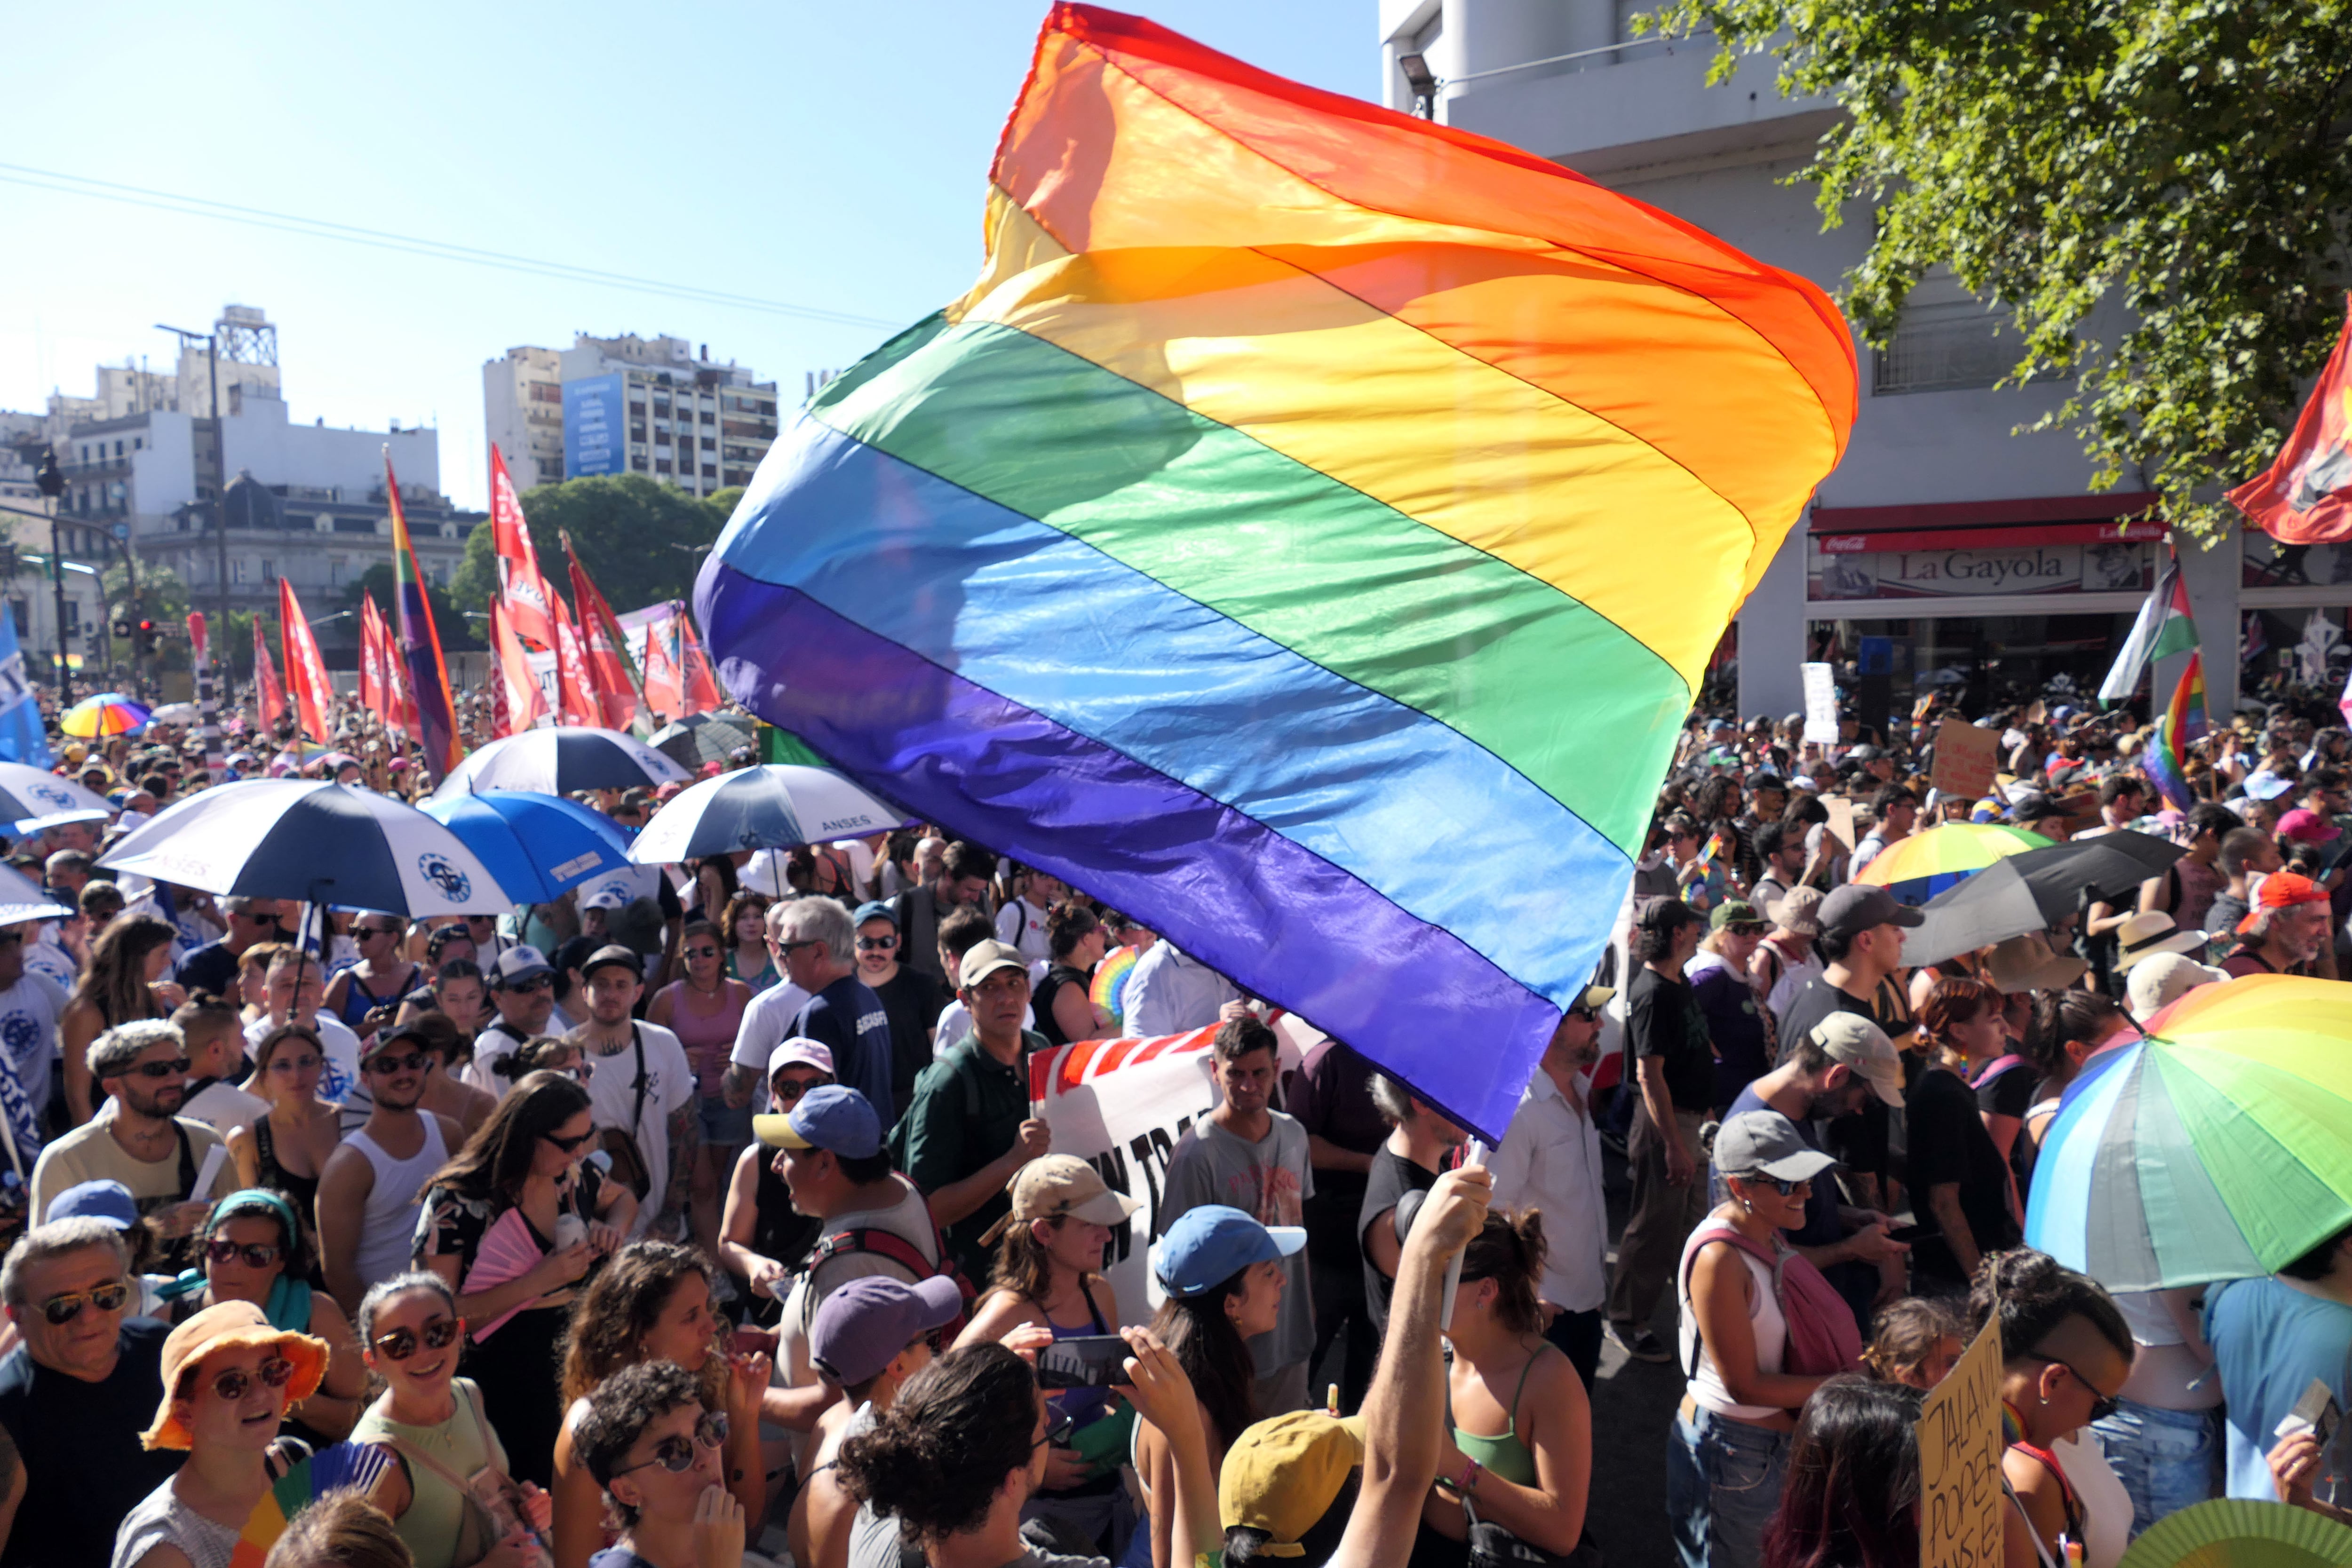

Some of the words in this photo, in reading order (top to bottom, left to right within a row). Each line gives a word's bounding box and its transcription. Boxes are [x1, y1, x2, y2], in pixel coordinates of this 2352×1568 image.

[1898, 553, 1938, 580] La
[1945, 549, 2063, 586] Gayola
[822, 814, 871, 831] ANSES
